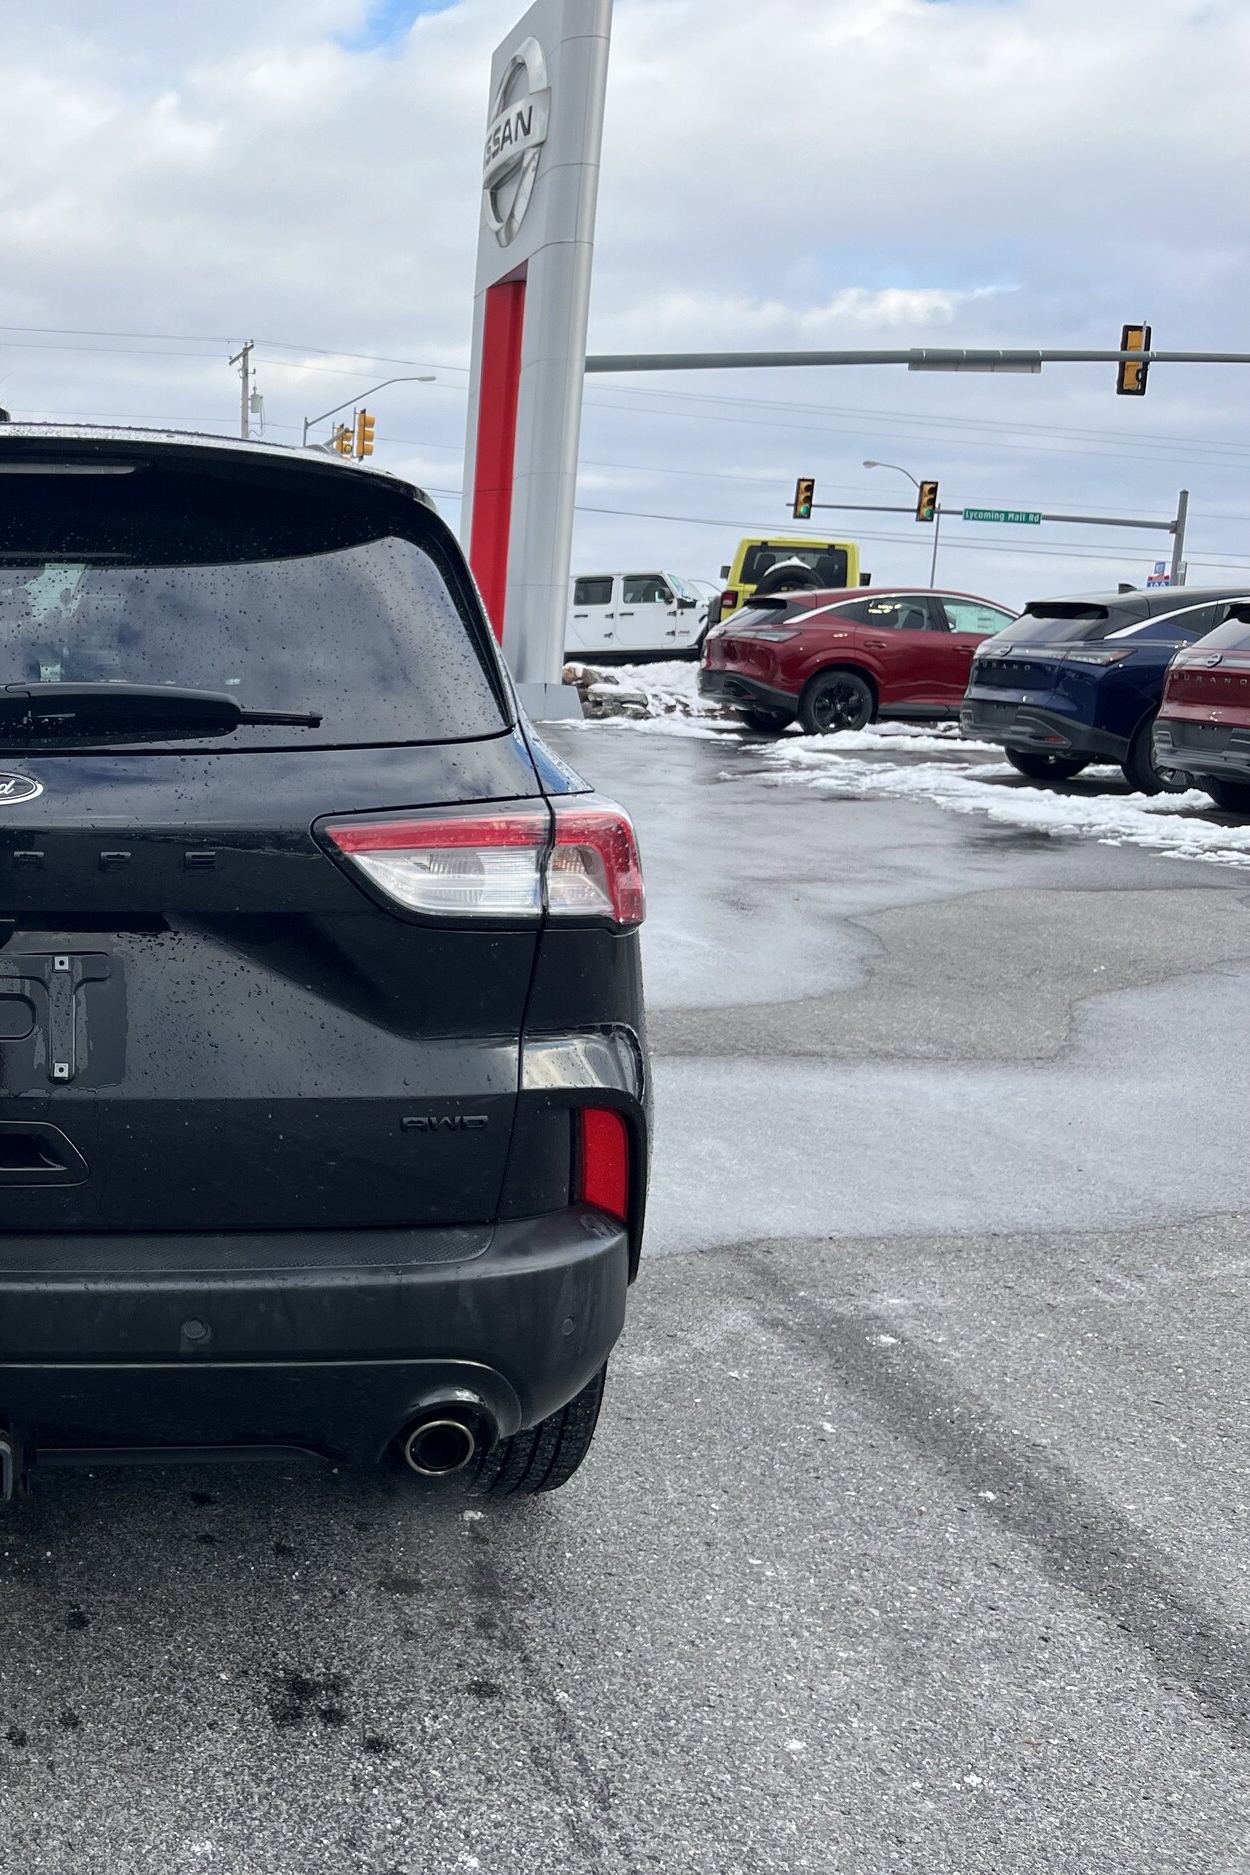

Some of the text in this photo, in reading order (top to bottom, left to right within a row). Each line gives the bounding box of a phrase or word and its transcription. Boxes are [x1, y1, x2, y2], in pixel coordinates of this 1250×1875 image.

[486, 105, 533, 167] SSAN
[965, 510, 1040, 523] Lycoming Mall Rd
[401, 1115, 489, 1132] AWD
